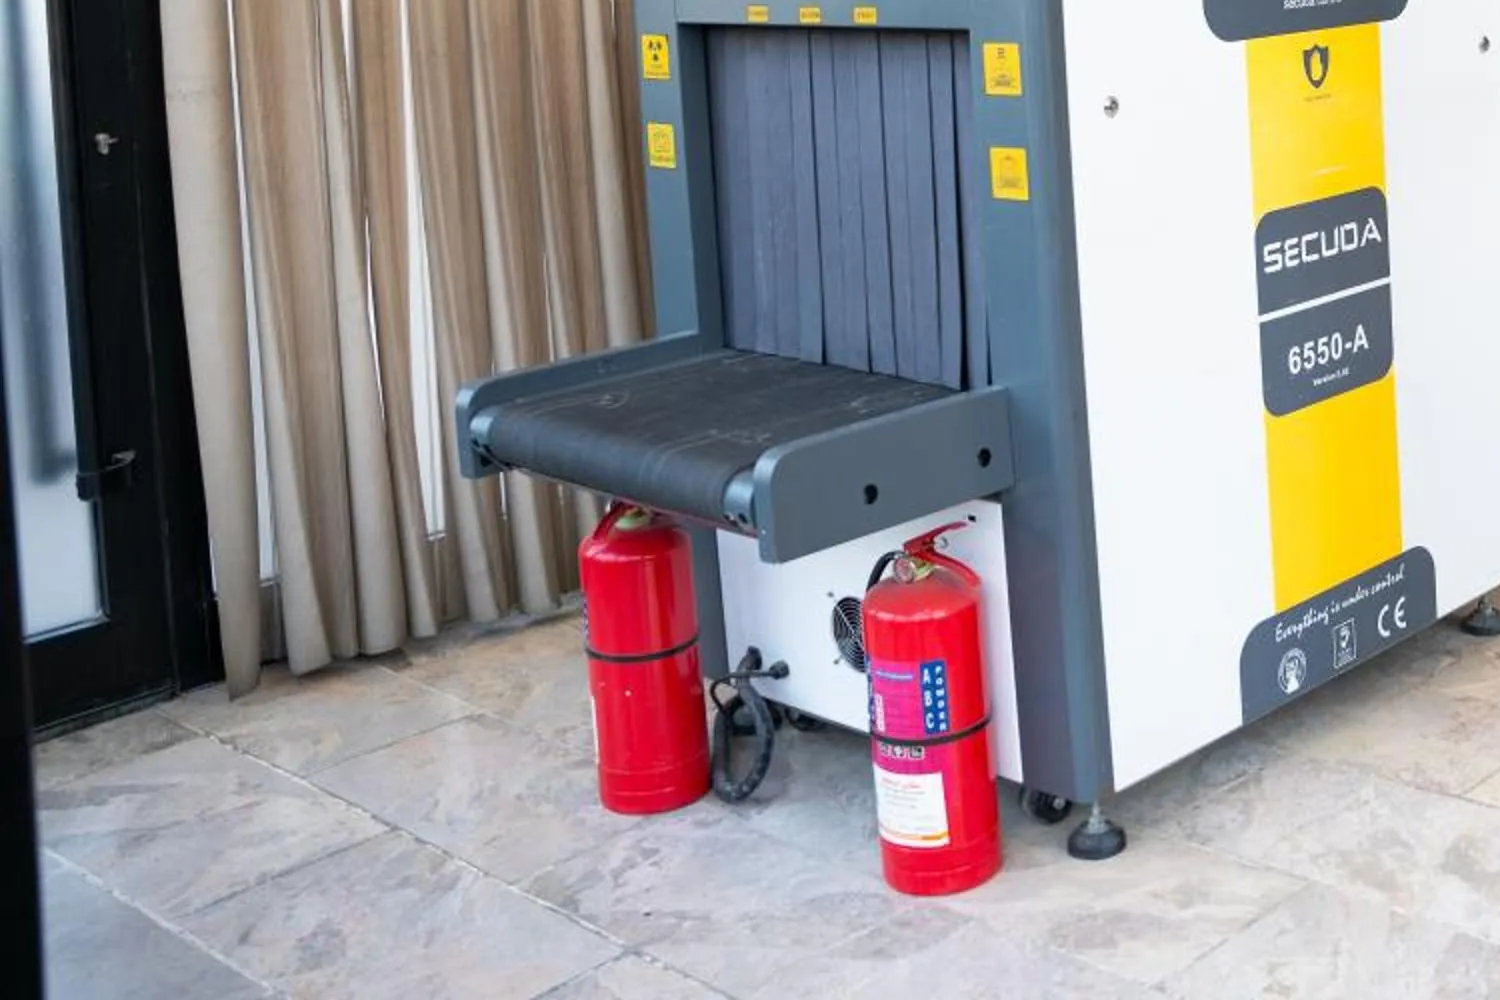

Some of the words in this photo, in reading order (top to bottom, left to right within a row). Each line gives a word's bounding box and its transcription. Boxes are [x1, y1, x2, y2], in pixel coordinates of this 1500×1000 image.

[1262, 217, 1383, 274] SECUDA
[1287, 324, 1369, 375] 6550-A
[1275, 607, 1329, 642] Everything
[1341, 585, 1369, 609] under
[1371, 562, 1405, 595] control
[1377, 595, 1407, 637] CE
